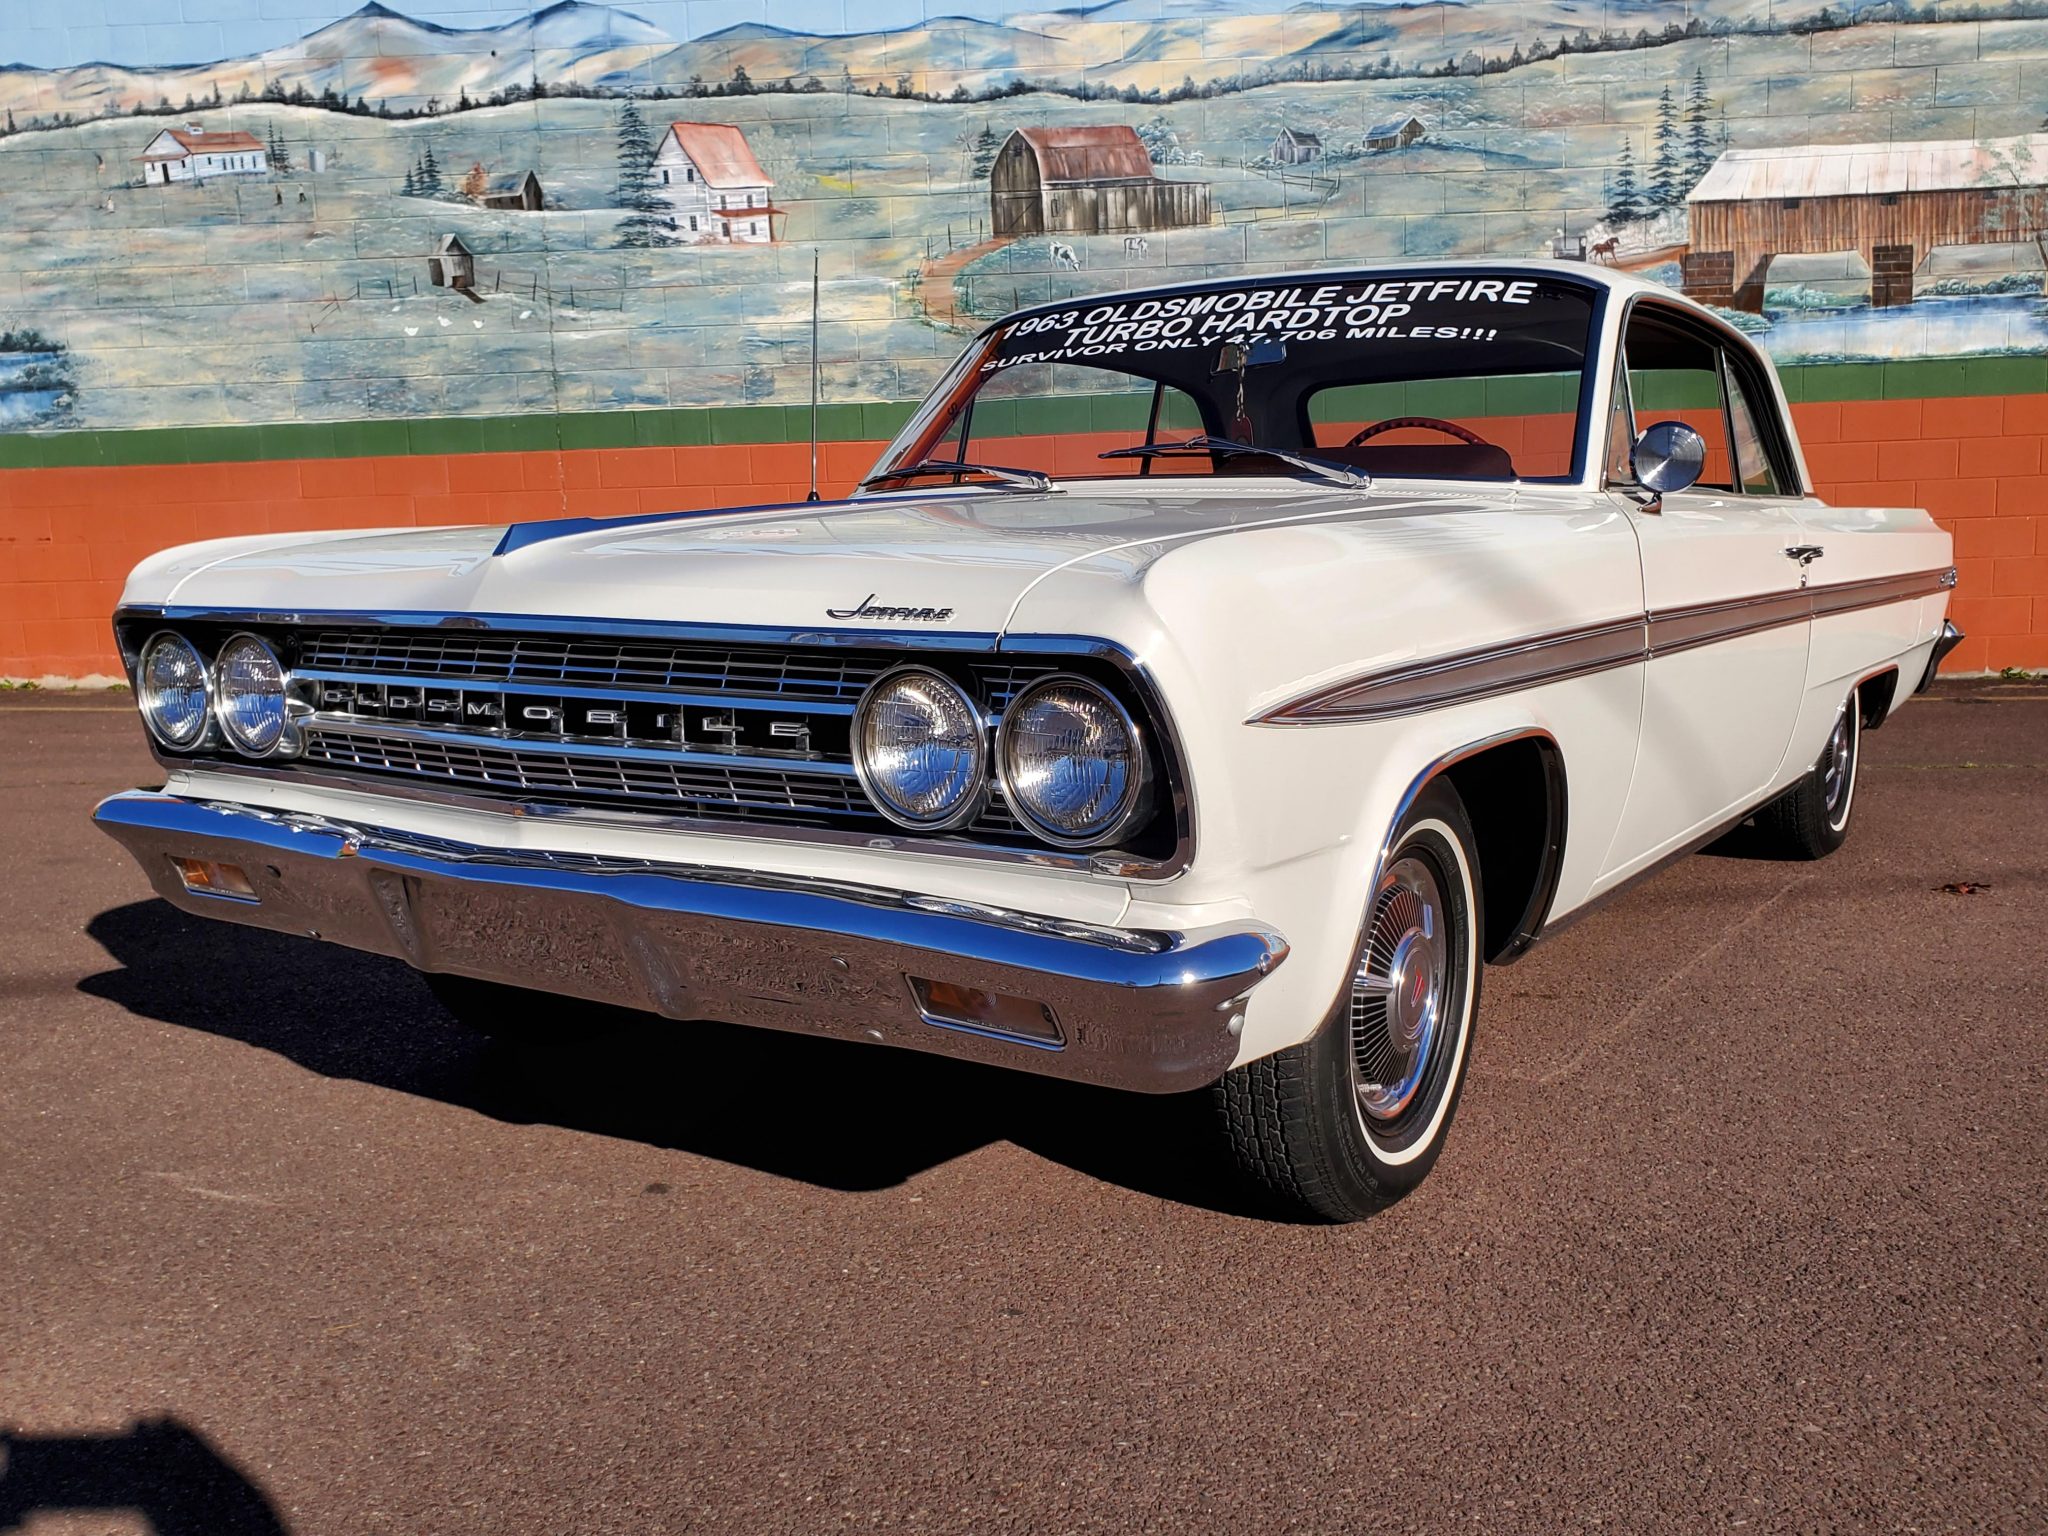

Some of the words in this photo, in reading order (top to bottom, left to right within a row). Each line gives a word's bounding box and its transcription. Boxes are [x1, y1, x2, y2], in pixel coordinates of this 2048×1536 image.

[1003, 311, 1079, 340] 1963
[1084, 286, 1343, 325] OLDSMOBILE
[1346, 280, 1538, 304] JETFIRE
[1064, 317, 1193, 347] TURBO
[1198, 303, 1411, 335] HARDTOP
[979, 343, 1129, 372] SURVIVOR
[1134, 335, 1220, 352] ONLY
[1225, 329, 1337, 345] 47,706
[1345, 327, 1498, 341] MILES!!!
[324, 689, 811, 737] OLDSMOBILE
